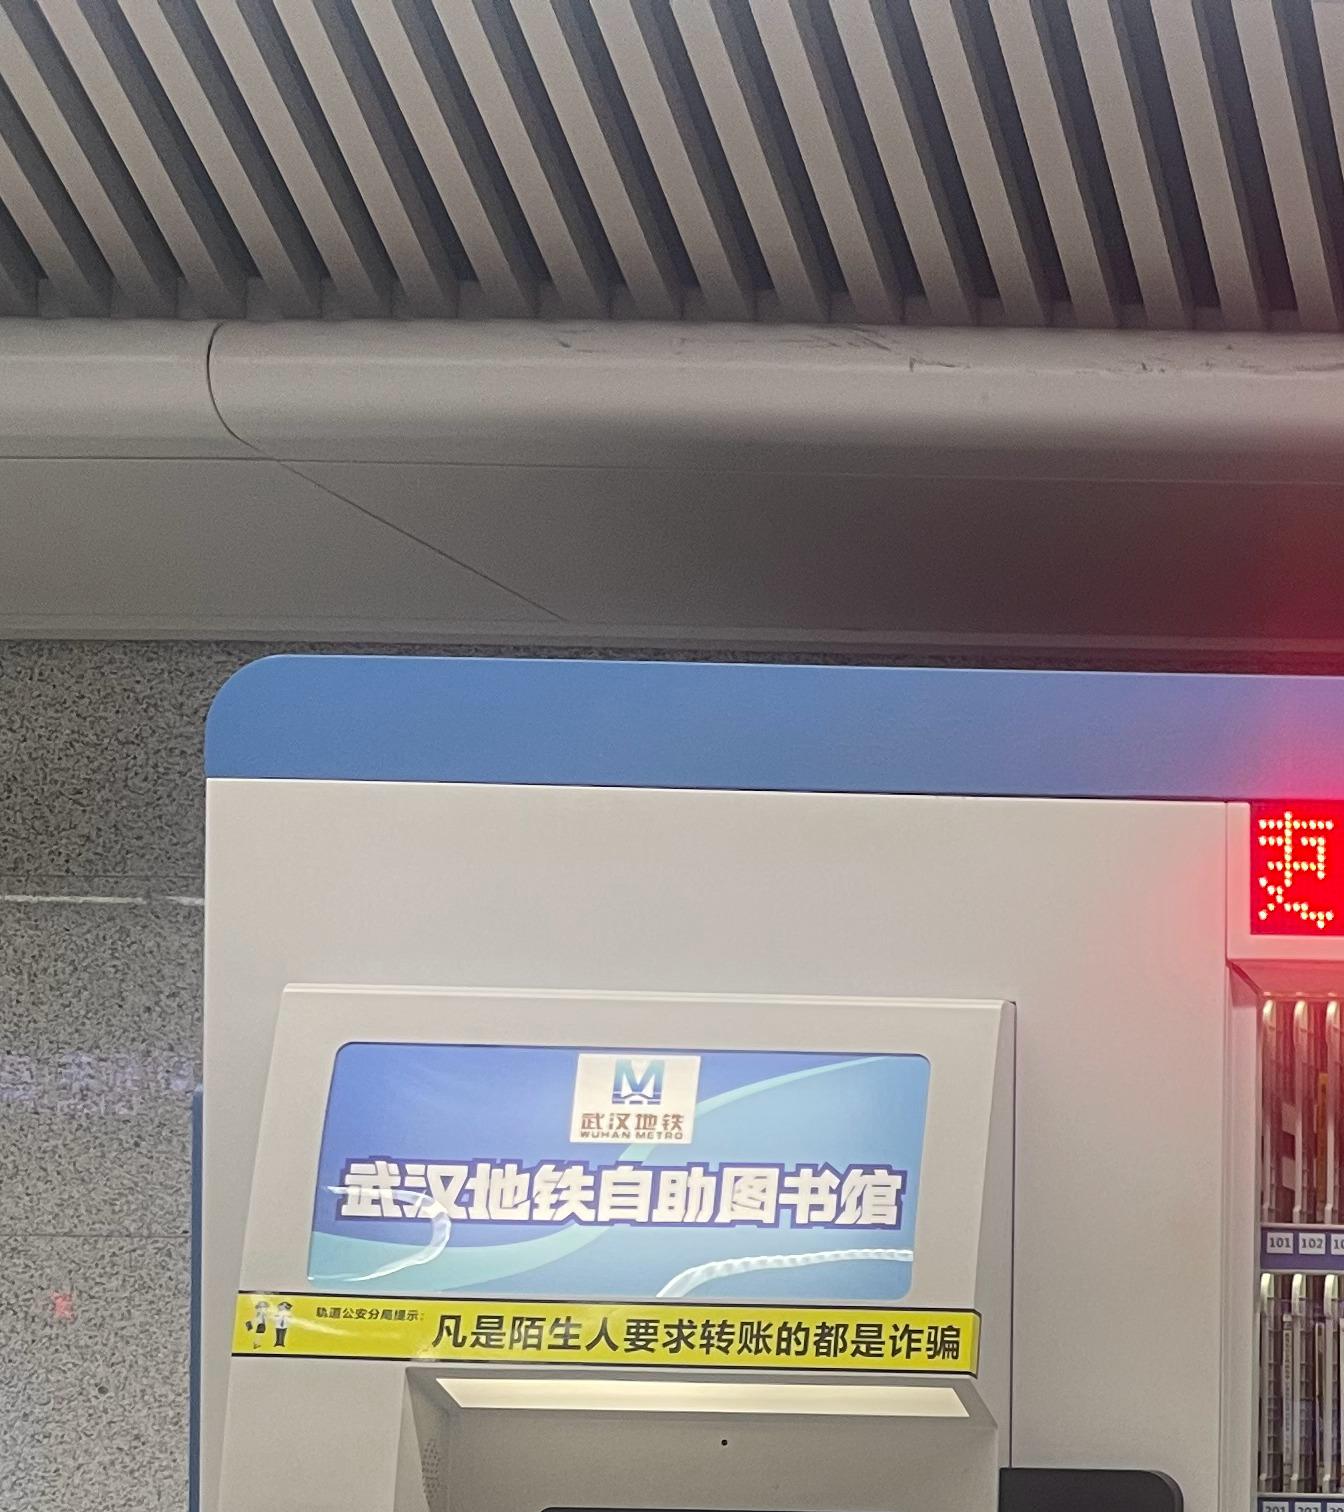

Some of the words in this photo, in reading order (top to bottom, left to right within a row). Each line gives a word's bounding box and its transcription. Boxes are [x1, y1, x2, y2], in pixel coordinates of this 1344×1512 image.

[581, 1113, 684, 1131] 武汉地铁
[580, 1131, 631, 1139] WUHAN
[635, 1131, 684, 1140] METRO
[342, 1161, 903, 1227] 武汉地铁自助图书馆
[1270, 1237, 1290, 1248] 101
[432, 1313, 961, 1361] 凡是陌生人要求转账的都是诈骗
